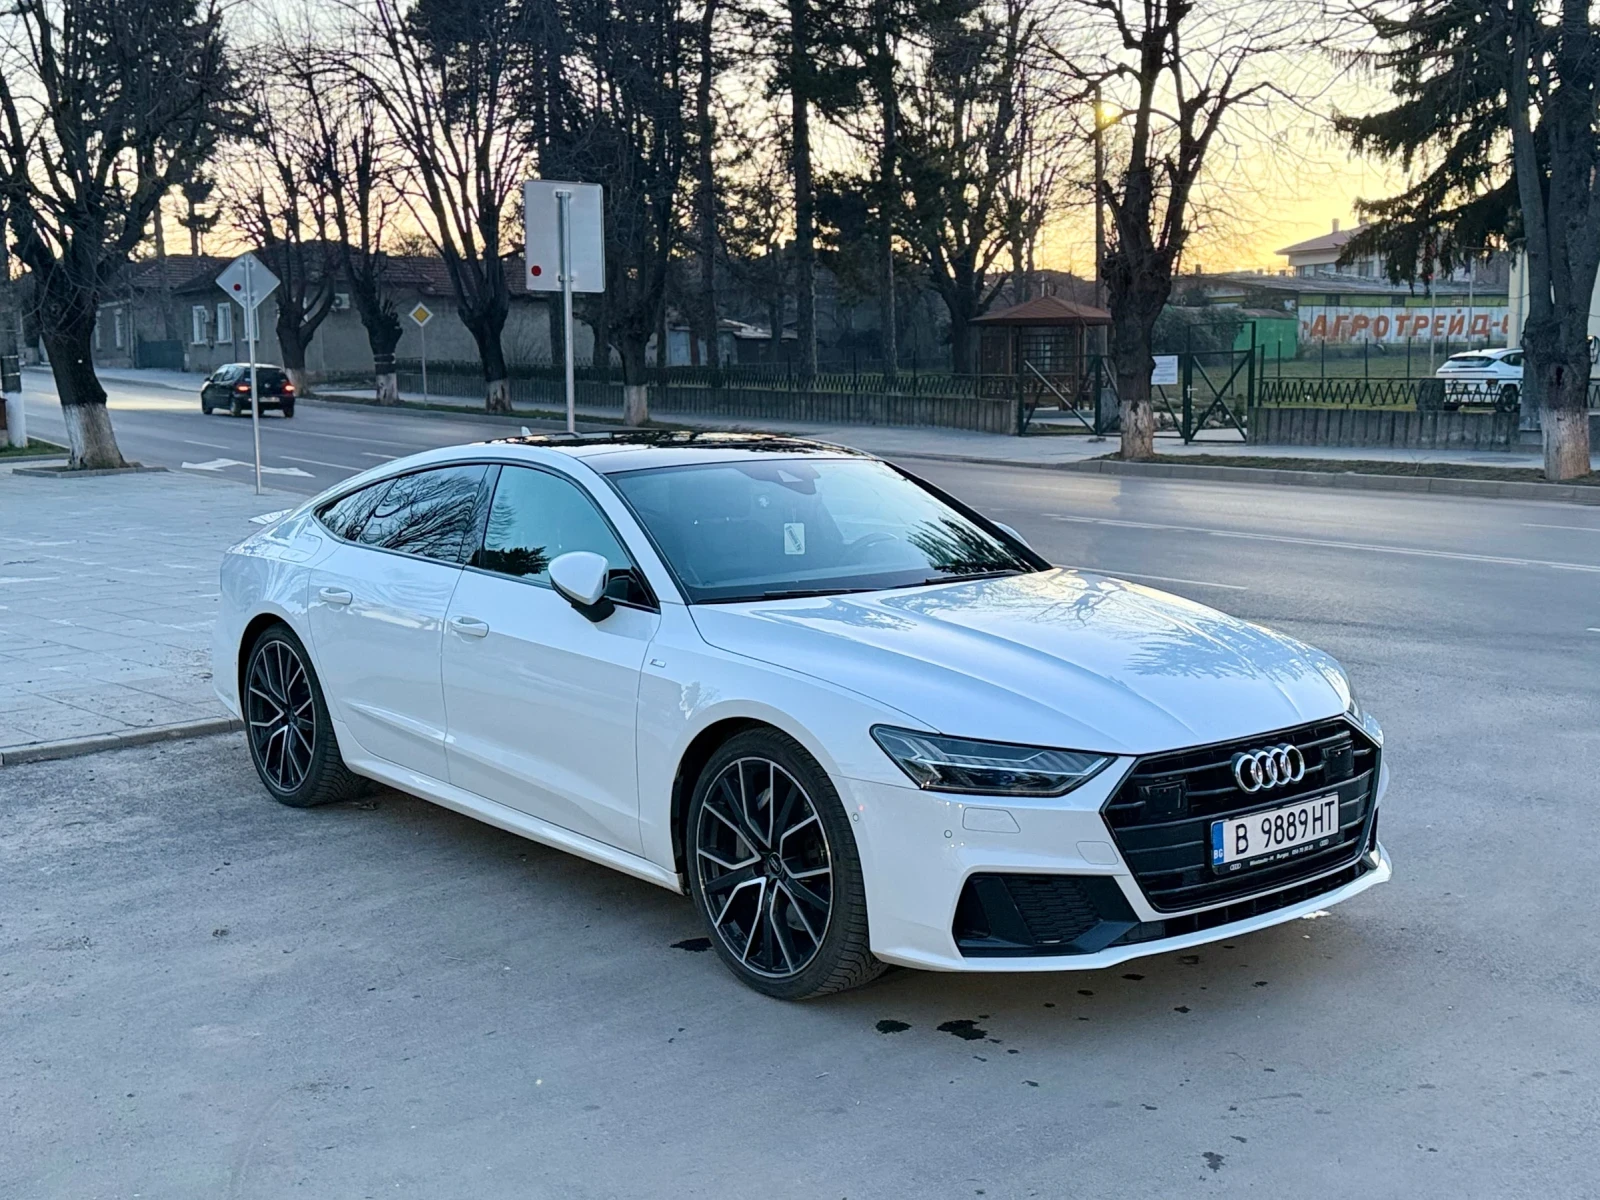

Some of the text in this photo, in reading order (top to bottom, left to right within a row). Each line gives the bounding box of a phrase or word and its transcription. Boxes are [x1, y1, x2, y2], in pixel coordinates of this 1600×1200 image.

[1309, 309, 1508, 337] АГРОТРЕЙД-
[1235, 823, 1249, 855] B
[1213, 848, 1224, 859] BG
